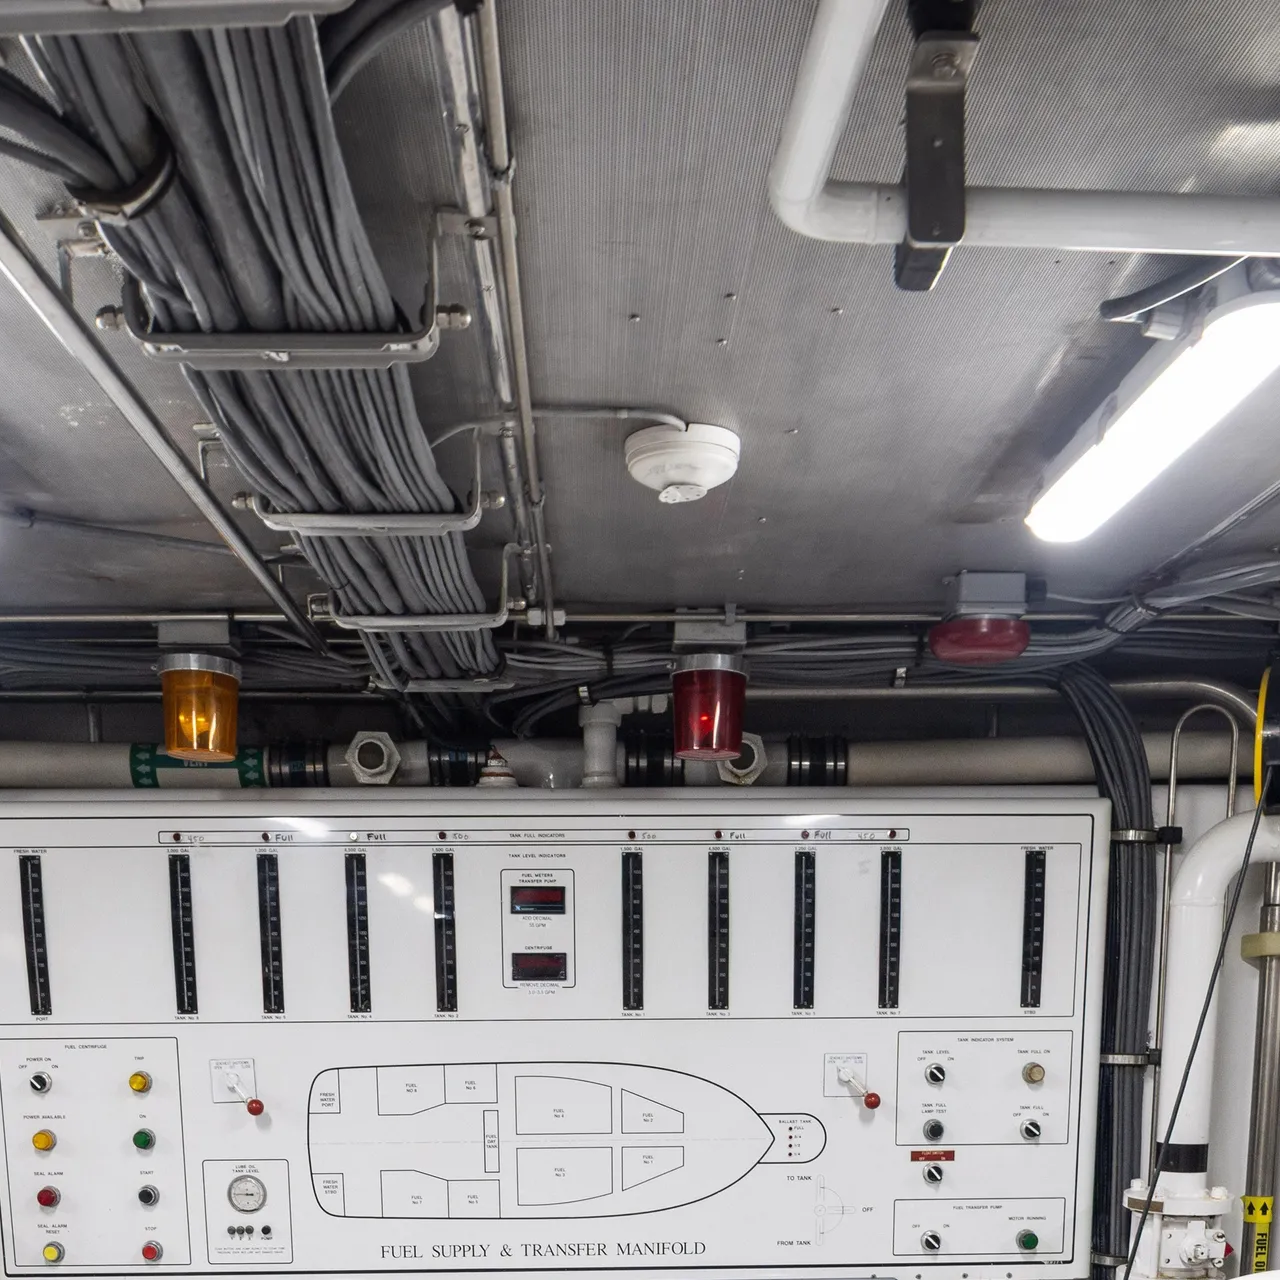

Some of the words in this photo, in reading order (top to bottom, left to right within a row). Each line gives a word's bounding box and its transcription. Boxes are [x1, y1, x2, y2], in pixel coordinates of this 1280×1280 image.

[275, 834, 294, 842] Full
[367, 833, 387, 841] Full
[729, 831, 746, 840] Full
[814, 830, 832, 840] Full
[1255, 1232, 1268, 1258] FUEL
[380, 1244, 423, 1258] FUEL
[431, 1244, 491, 1258] SUPPLY
[500, 1244, 513, 1258] &
[520, 1242, 608, 1257] TRANSFER
[616, 1242, 706, 1256] MANIFOLD
